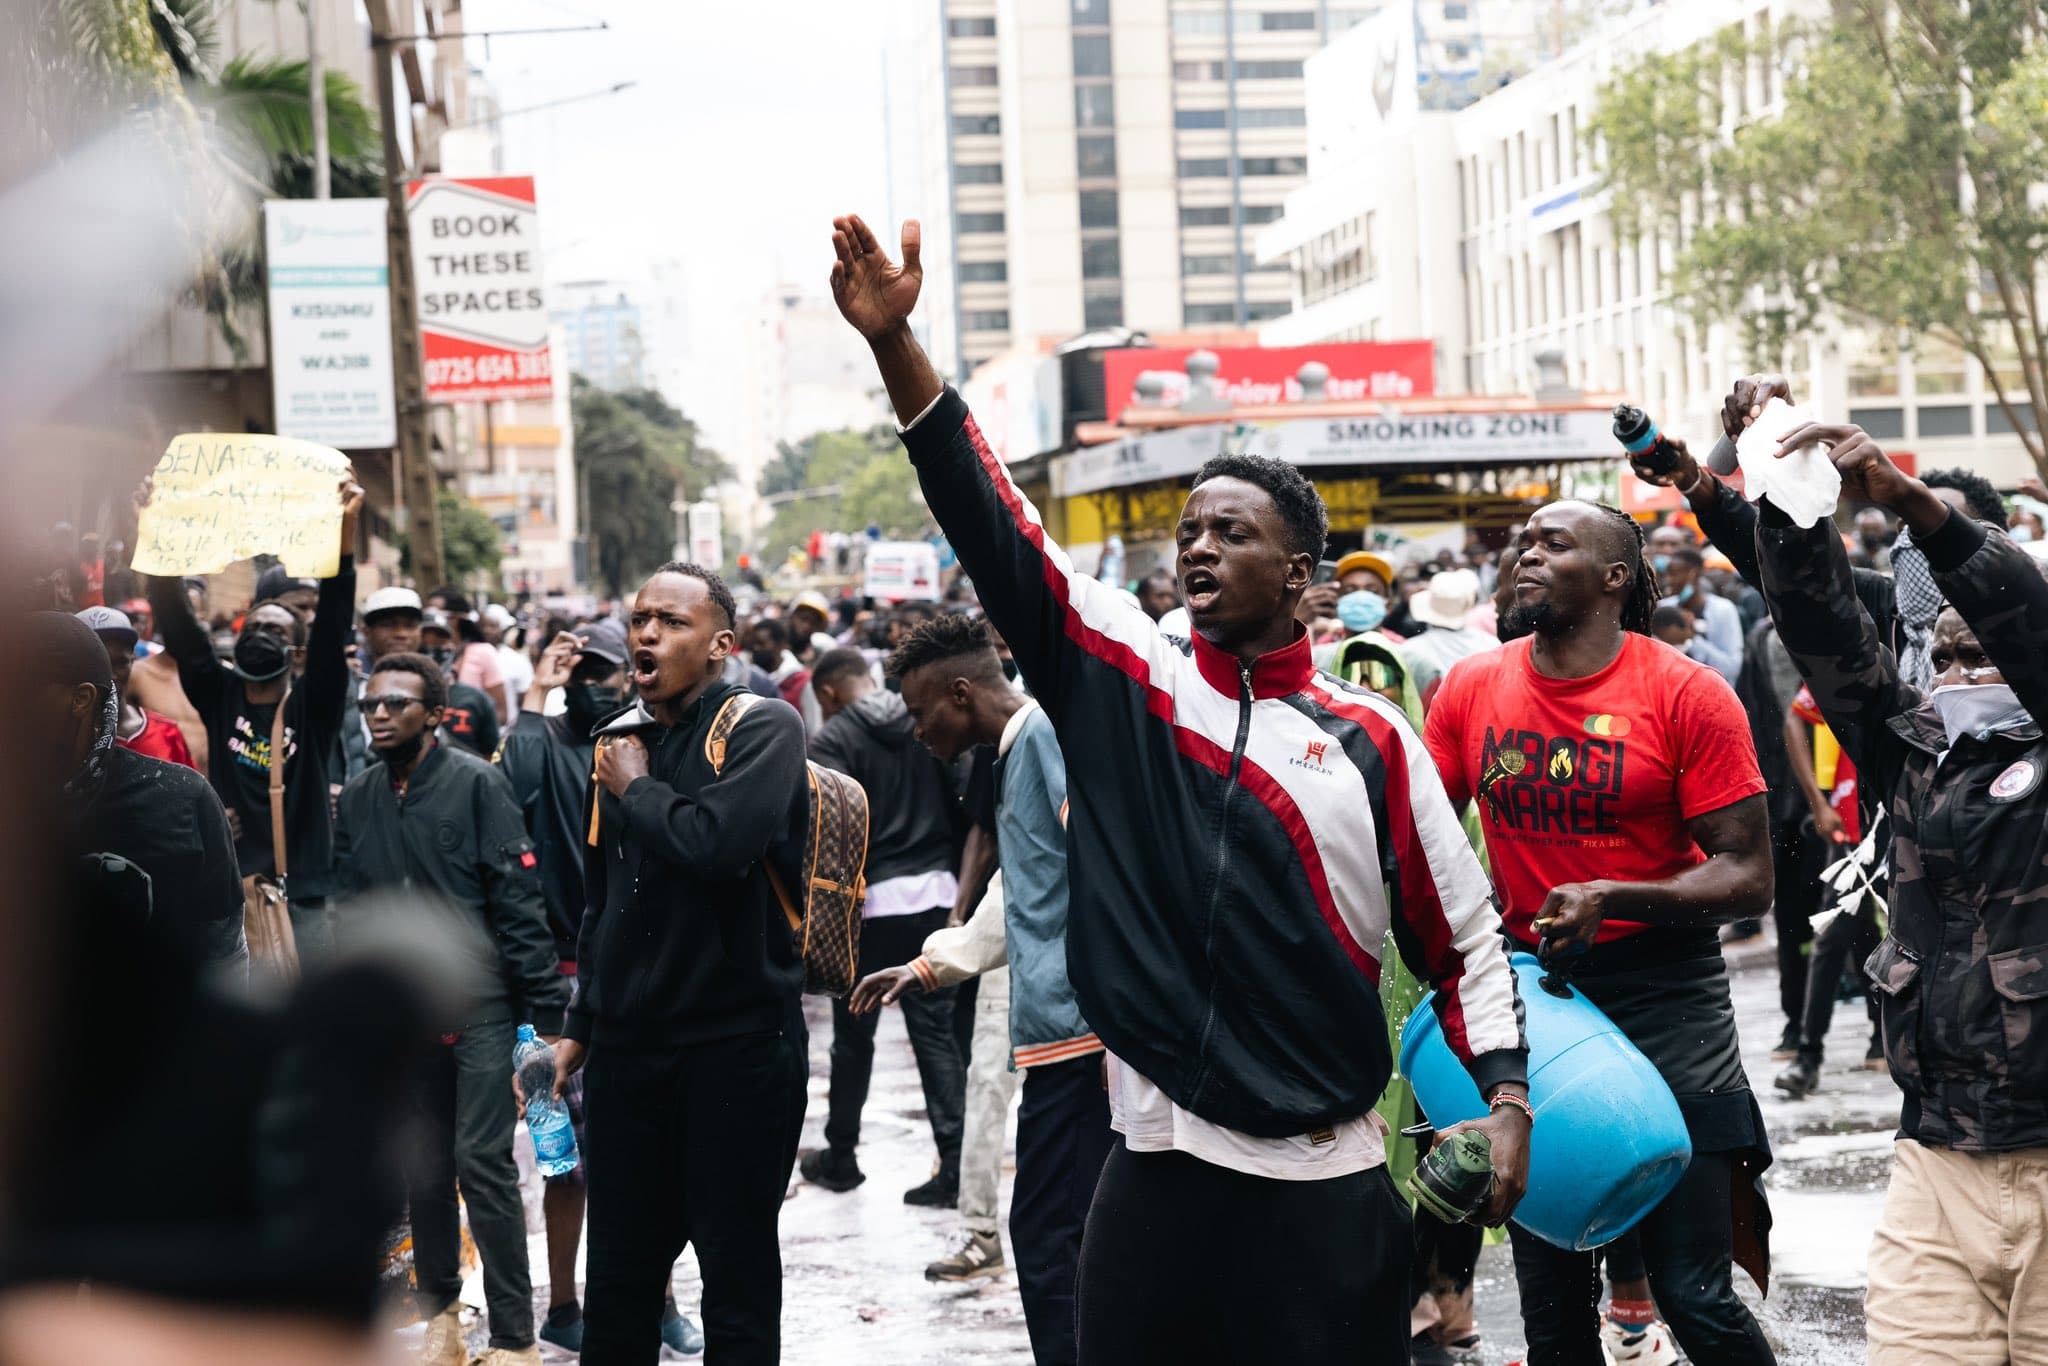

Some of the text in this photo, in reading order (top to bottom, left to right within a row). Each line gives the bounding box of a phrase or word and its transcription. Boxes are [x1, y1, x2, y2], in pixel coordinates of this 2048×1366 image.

[432, 215, 520, 238] BOOK
[428, 251, 530, 275] THESE
[291, 302, 373, 320] KISUMU
[424, 288, 544, 315] SPACES
[1370, 369, 1413, 398] life
[1327, 412, 1569, 442] SMOKING ZONE
[156, 443, 281, 475] SENATOR
[1481, 726, 1625, 794] MBOGI
[1462, 1149, 1480, 1164] AIR
